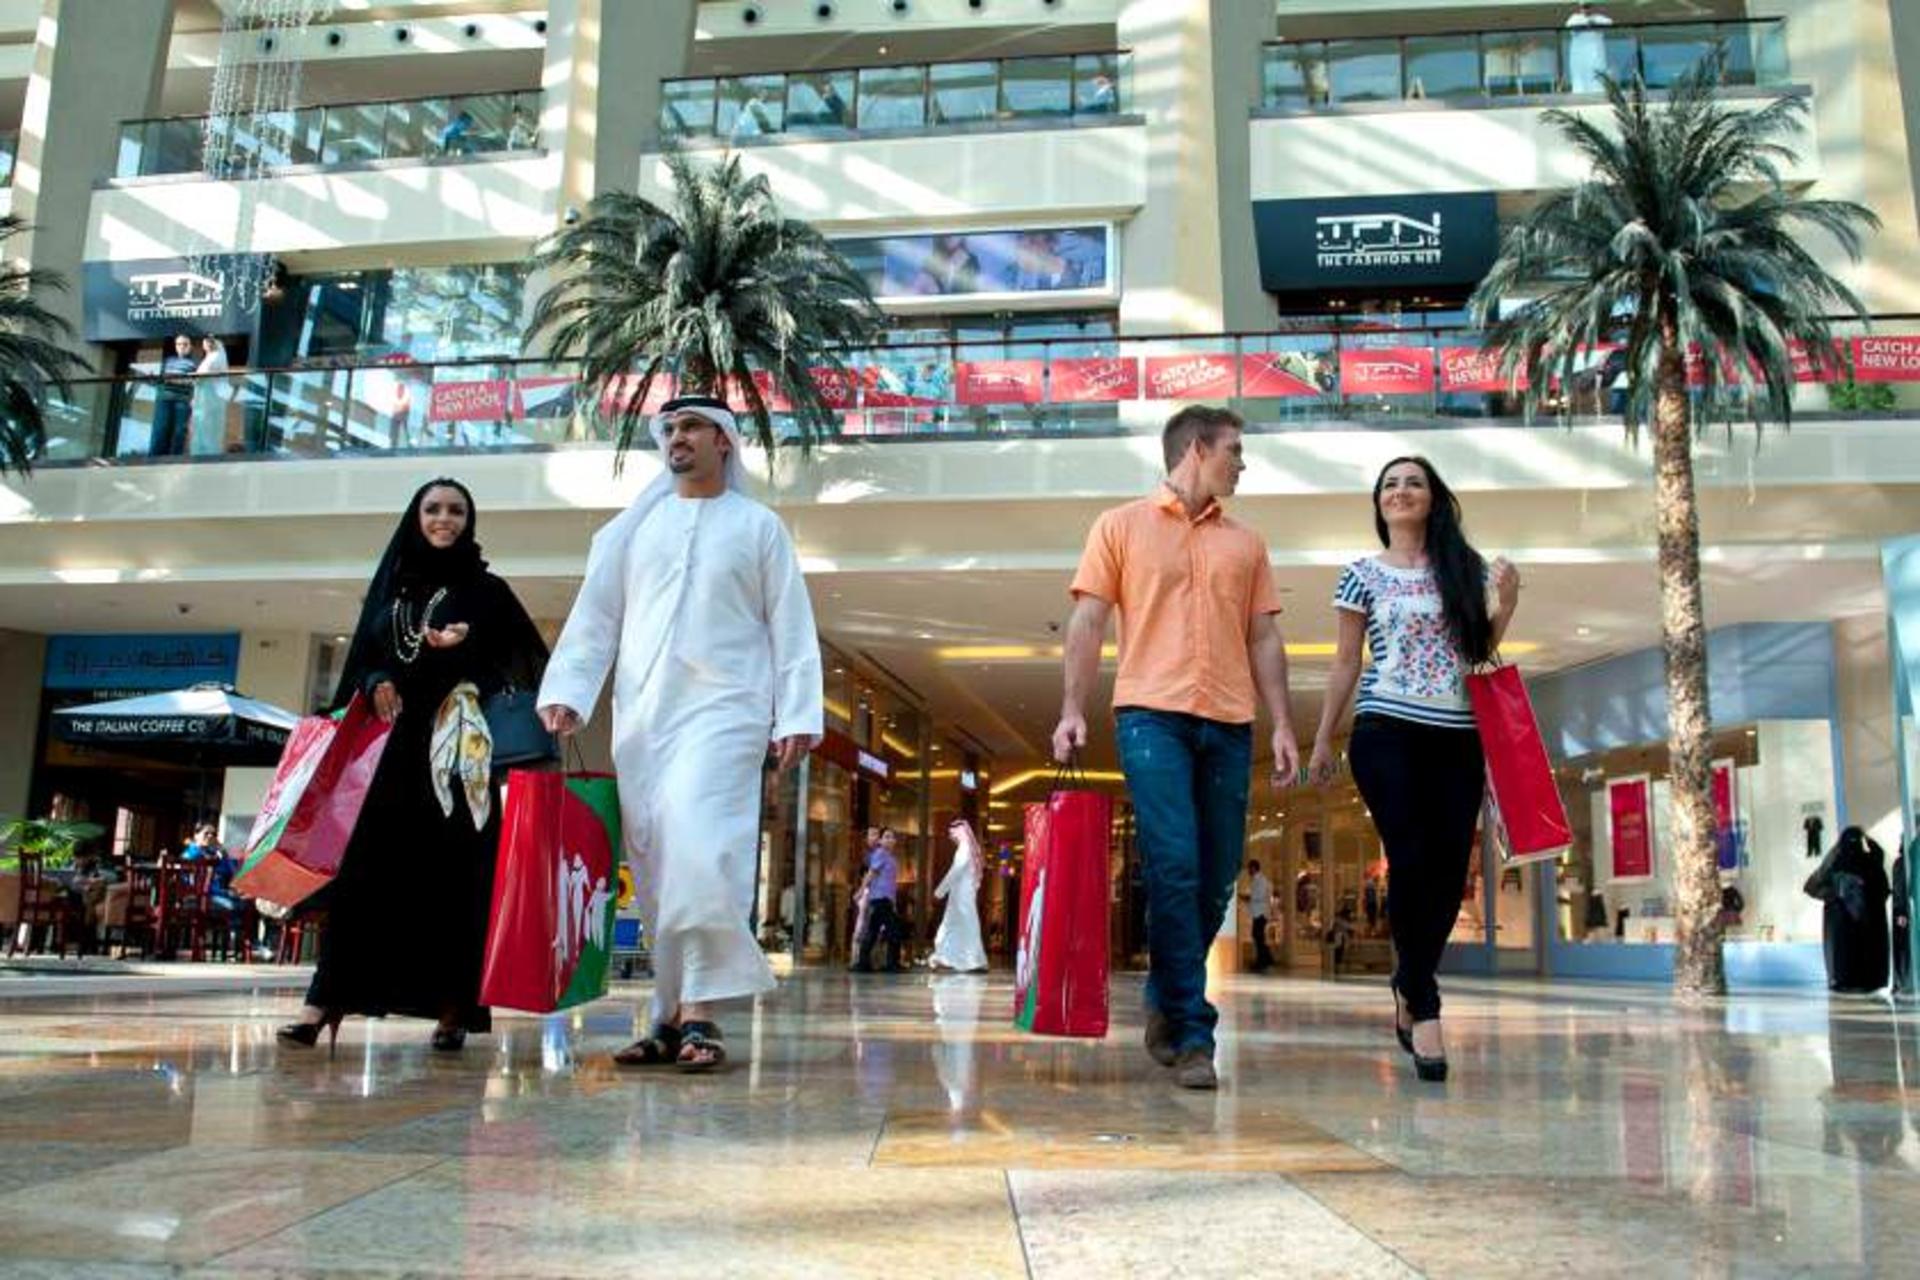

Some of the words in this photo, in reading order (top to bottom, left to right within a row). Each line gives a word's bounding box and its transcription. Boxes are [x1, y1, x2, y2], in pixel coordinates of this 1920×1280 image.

[1317, 253, 1342, 267] THE
[1347, 252, 1411, 267] FASHION
[1415, 250, 1441, 264] NET
[1862, 340, 1912, 355] CATCH
[1862, 354, 1898, 368] NEW
[1901, 355, 1920, 369] LO
[1152, 361, 1198, 384] CATCH
[1449, 366, 1485, 384] NEW
[72, 719, 94, 733] THE
[95, 720, 139, 733] ITALIAN
[140, 719, 184, 733] COFFEE
